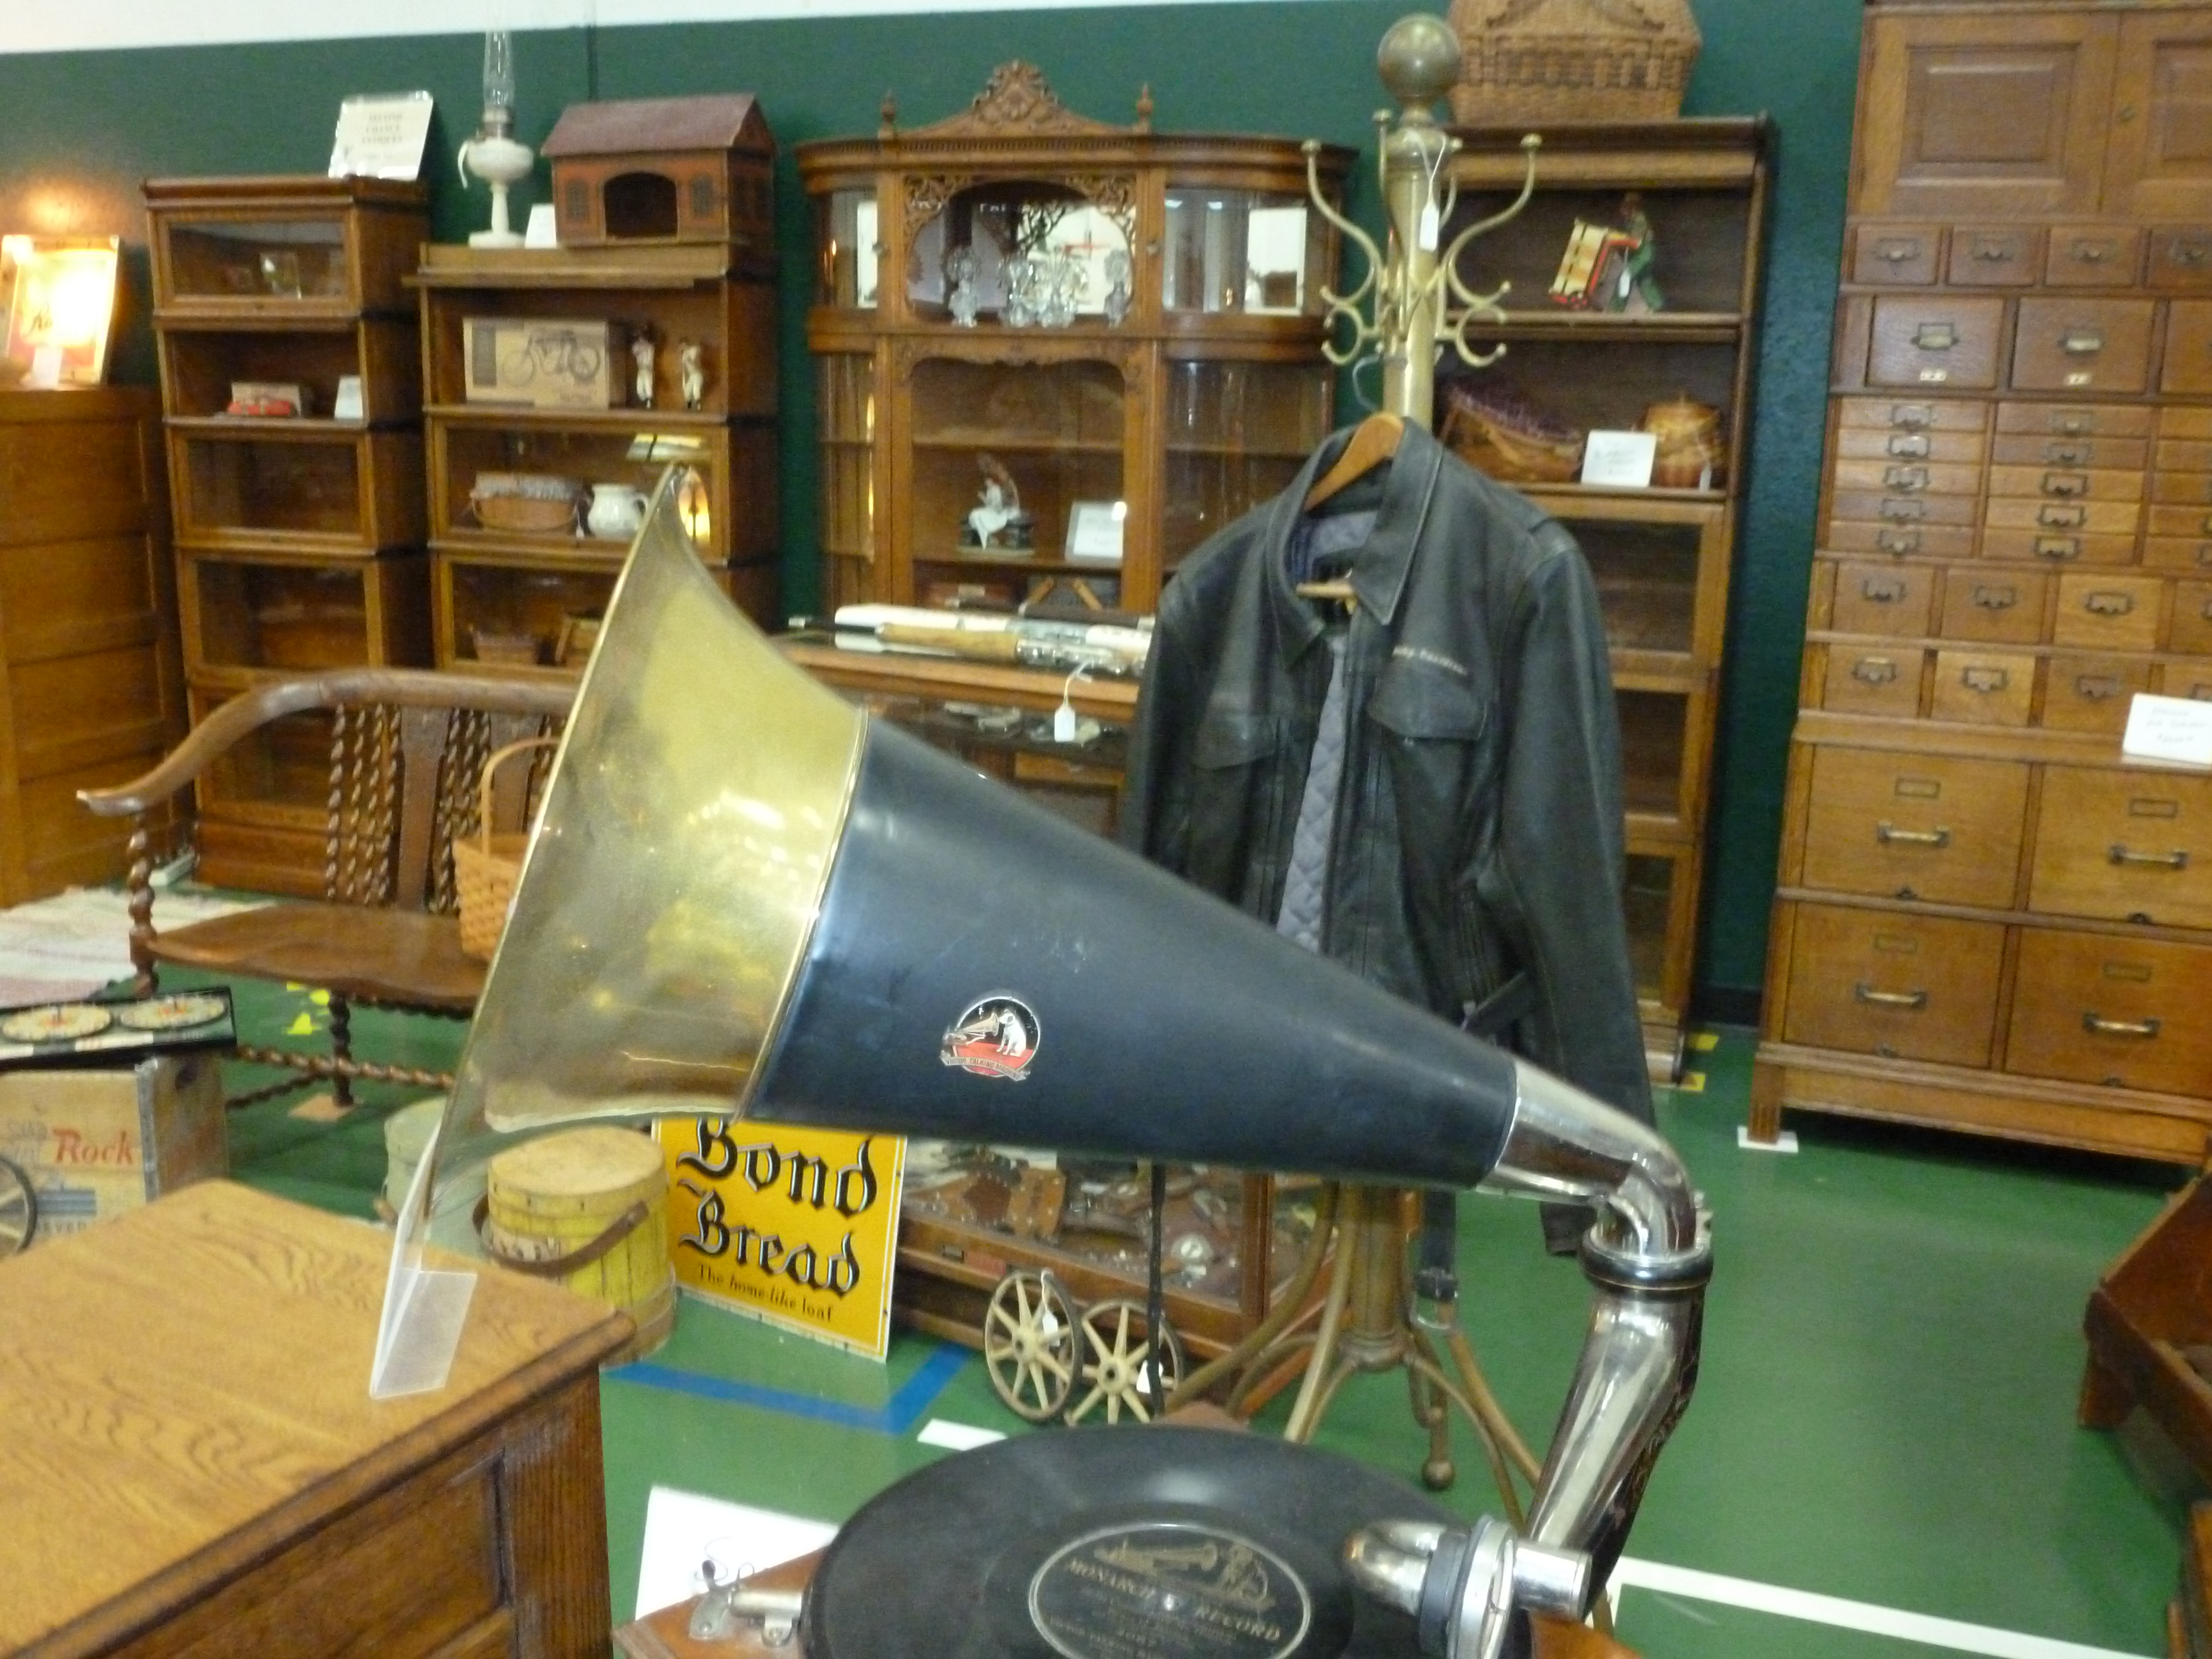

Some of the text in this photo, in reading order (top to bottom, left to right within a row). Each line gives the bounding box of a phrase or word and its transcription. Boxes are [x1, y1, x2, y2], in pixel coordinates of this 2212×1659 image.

[969, 1058, 994, 1069] TALKING
[53, 1128, 133, 1165] Rock
[676, 1118, 877, 1219] Bond
[676, 1179, 860, 1301] Bread
[700, 1263, 834, 1323] The home like loaf
